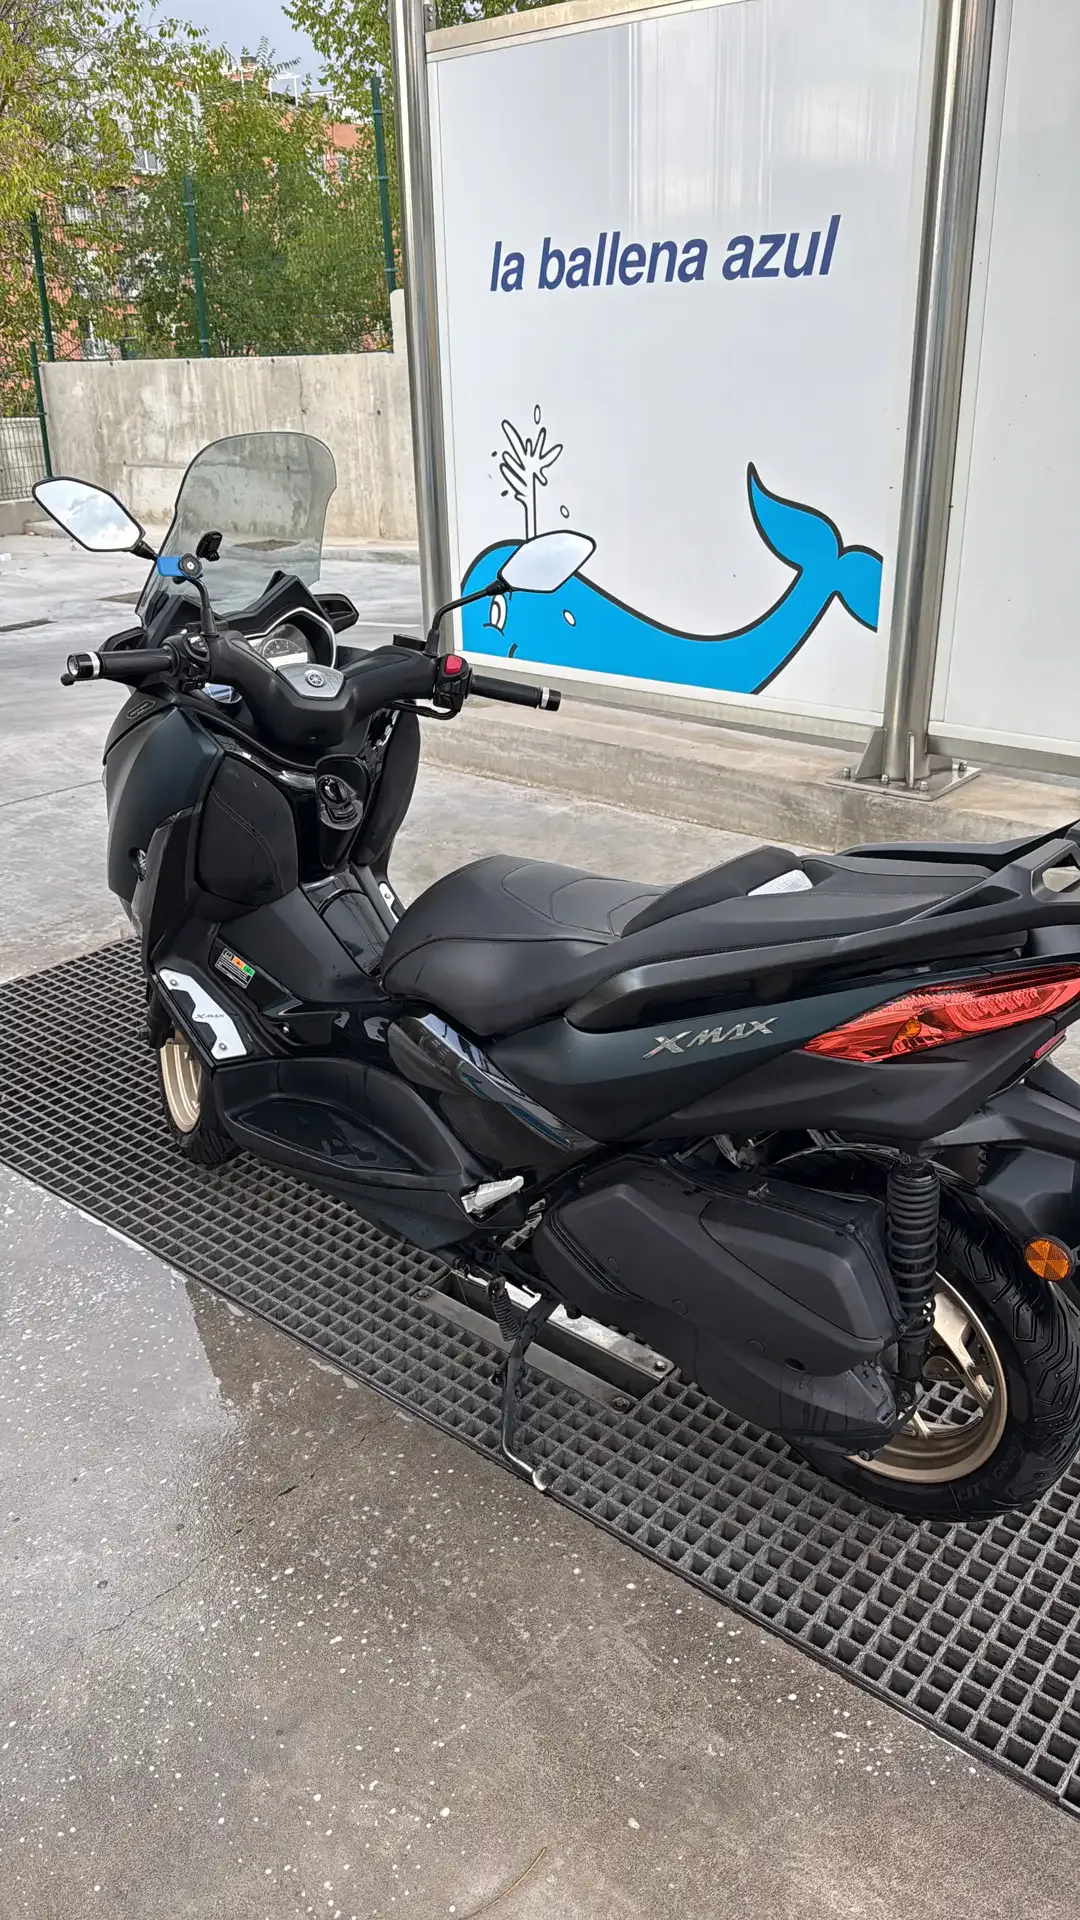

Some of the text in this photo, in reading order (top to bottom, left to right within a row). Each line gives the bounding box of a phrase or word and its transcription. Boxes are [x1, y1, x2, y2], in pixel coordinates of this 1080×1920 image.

[490, 215, 841, 292] la ballena azul
